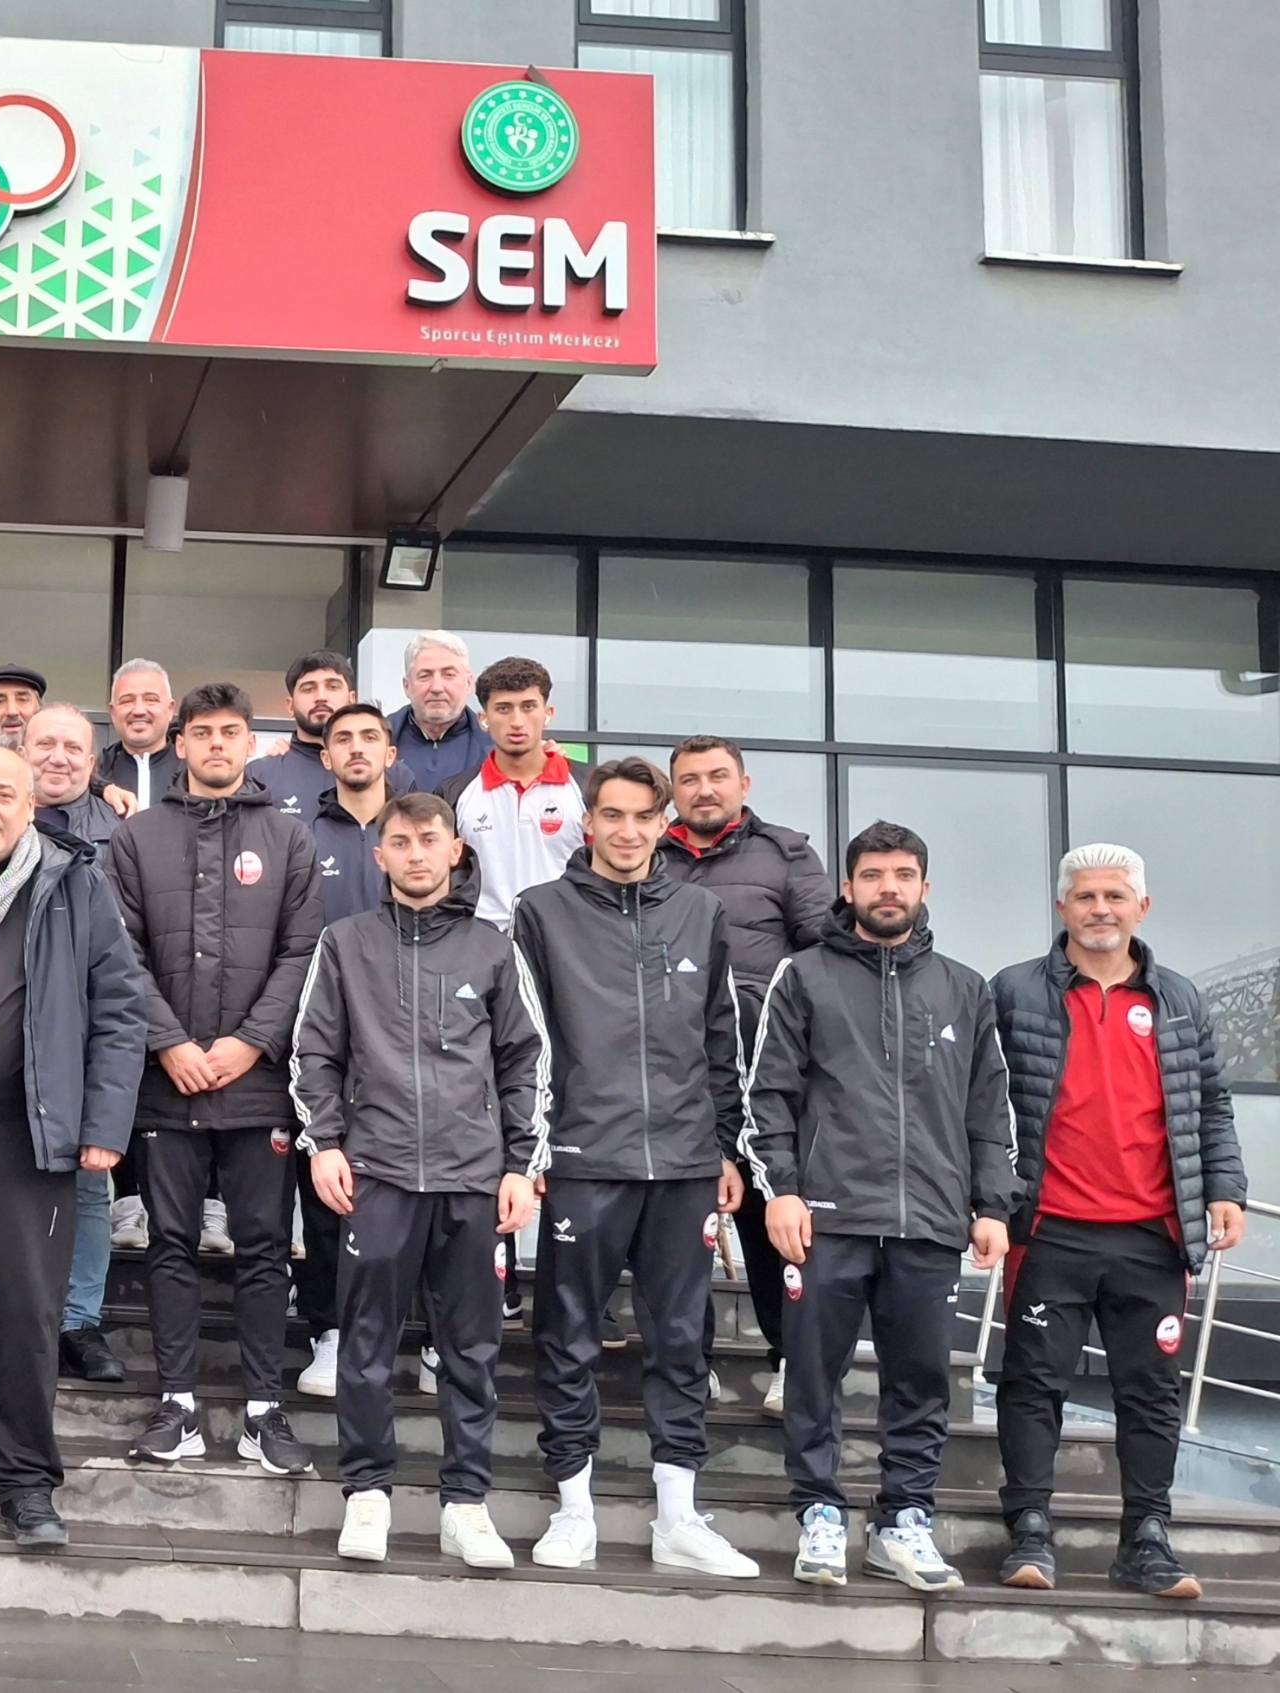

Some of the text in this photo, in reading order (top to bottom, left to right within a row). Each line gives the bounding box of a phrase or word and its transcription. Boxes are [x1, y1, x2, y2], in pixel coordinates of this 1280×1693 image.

[407, 210, 628, 312] SEM
[420, 325, 481, 342] Sporcu
[548, 332, 621, 349] Merkezi
